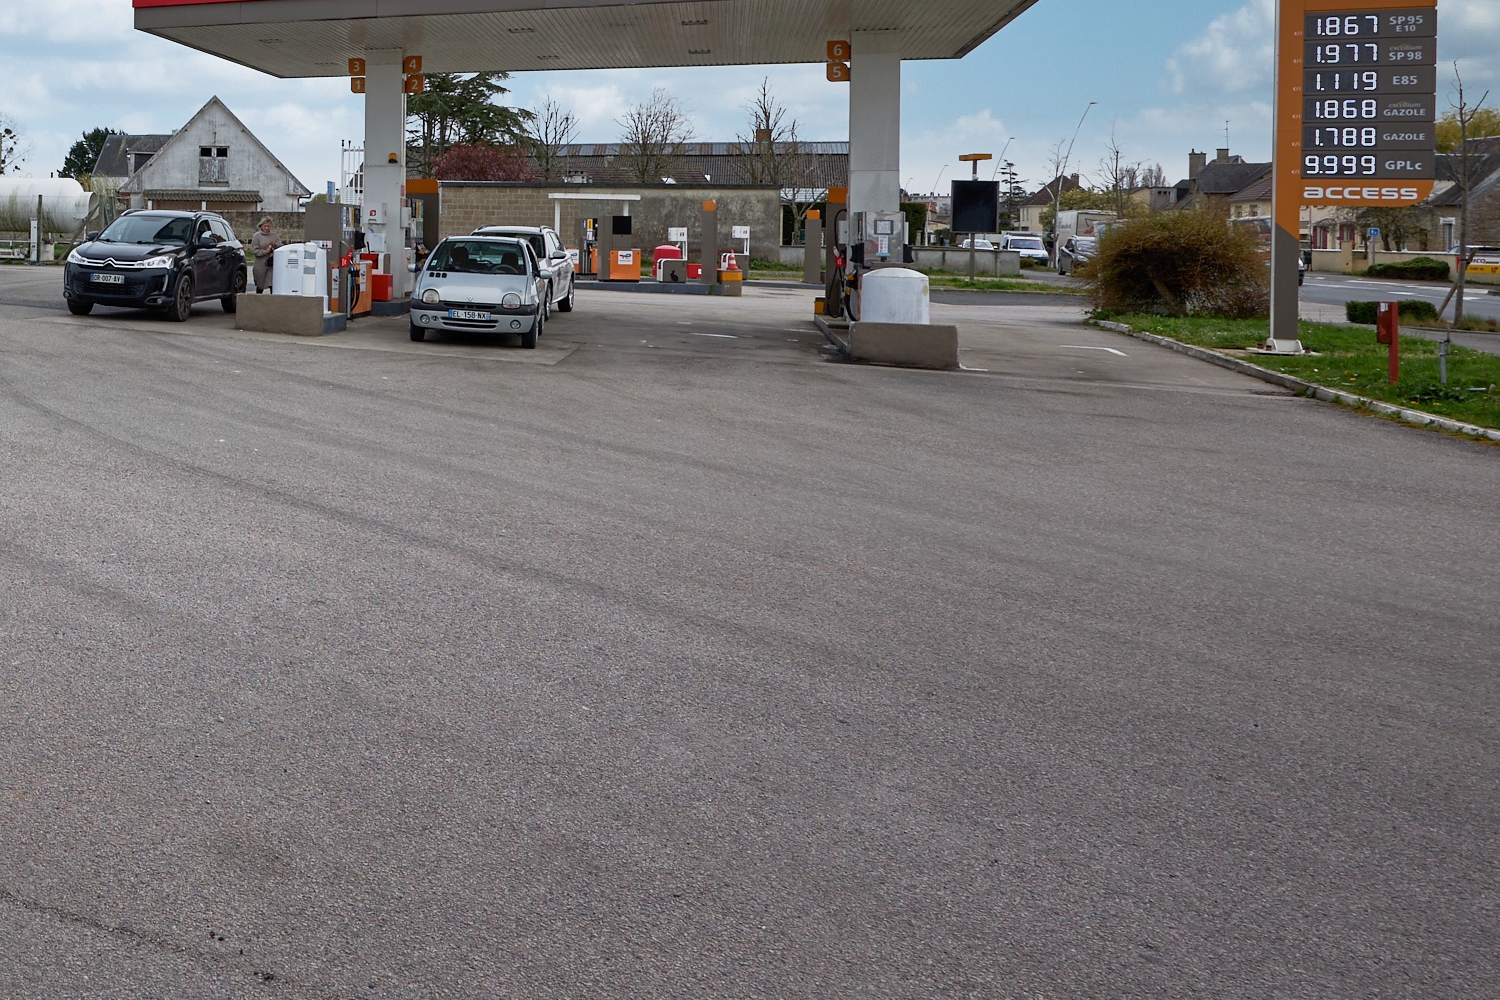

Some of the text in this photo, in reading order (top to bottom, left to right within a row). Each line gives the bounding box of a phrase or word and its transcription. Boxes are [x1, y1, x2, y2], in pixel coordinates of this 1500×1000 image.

[1317, 15, 1378, 36] 1.867
[833, 44, 843, 56] 6
[1316, 43, 1378, 63] 1.977
[353, 62, 360, 72] 3
[409, 59, 417, 70] 4
[833, 66, 842, 78] 5
[355, 80, 361, 90] 1
[411, 79, 418, 90] 2
[1316, 71, 1378, 91] 1.119
[1392, 75, 1418, 85] E85
[1316, 99, 1377, 119] 1.868
[1383, 108, 1426, 116] GAZOLE
[1315, 127, 1377, 147] 1.788
[1382, 133, 1426, 141] GAZOLE
[1304, 155, 1377, 175] 9.999
[1384, 160, 1423, 170] GPLc
[1303, 186, 1418, 200] access
